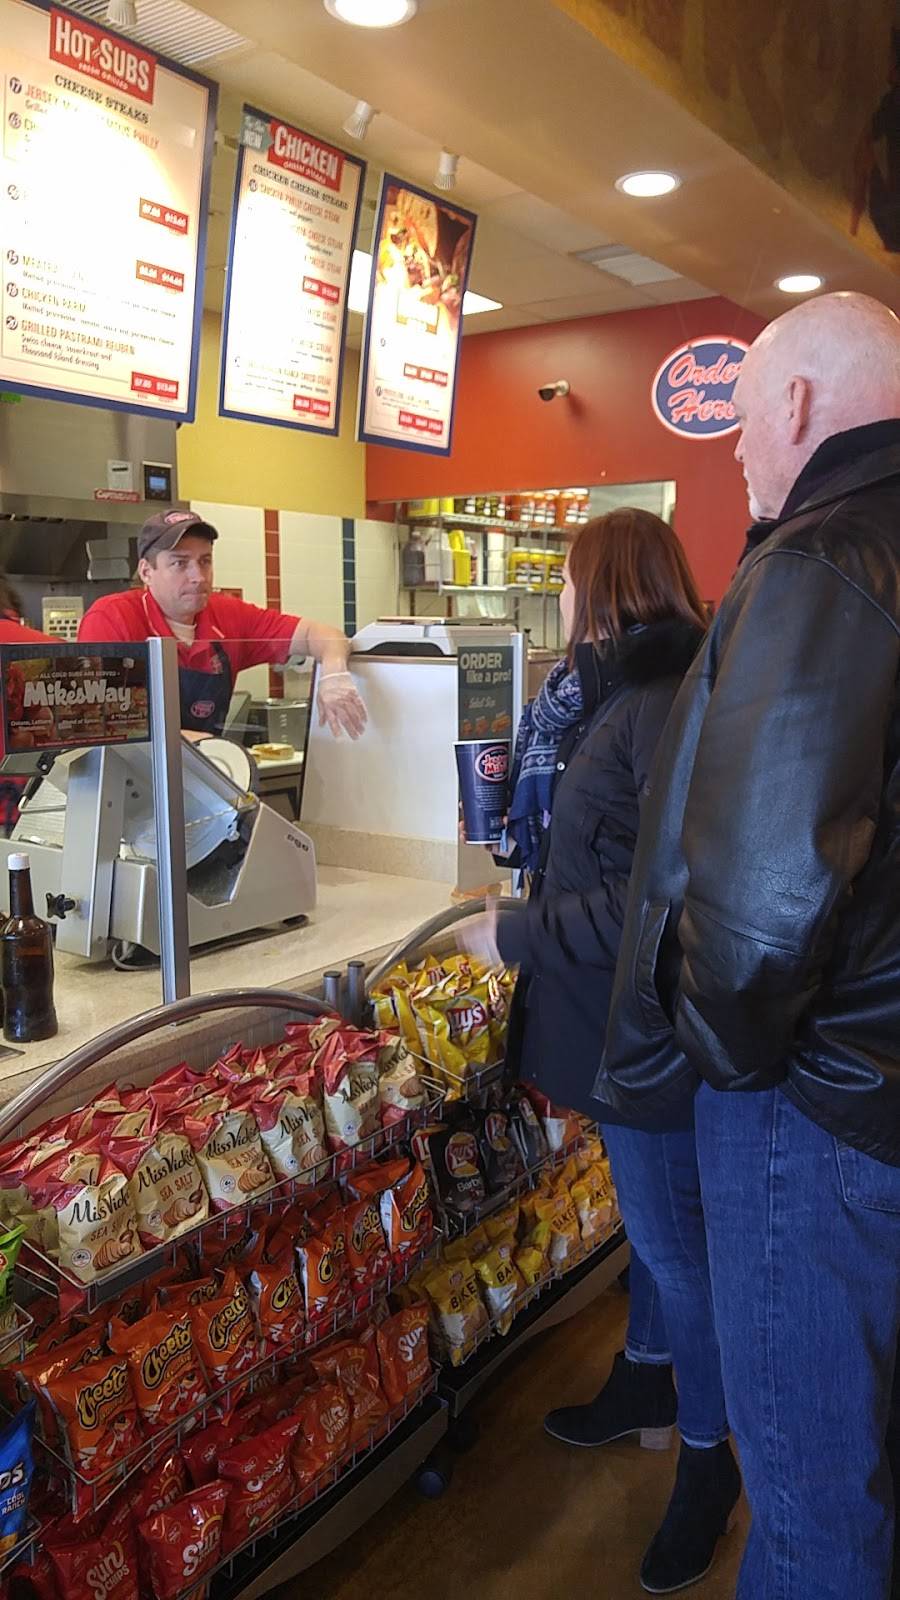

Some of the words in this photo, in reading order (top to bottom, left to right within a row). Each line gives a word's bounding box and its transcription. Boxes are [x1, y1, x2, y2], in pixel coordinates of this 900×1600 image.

[55, 16, 95, 63] HOT
[99, 38, 150, 93] SUBS
[54, 74, 103, 104] CHEESE
[105, 96, 150, 124] STEAKS
[274, 125, 338, 181] CHICKEN
[22, 287, 59, 307] CHICKEN
[21, 319, 57, 339] GRILLED
[59, 328, 102, 349] PASTRAMI
[105, 339, 136, 356] REUBEN
[21, 344, 52, 361] Thousand
[75, 355, 100, 373] dressing
[668, 352, 742, 388] Orde
[460, 652, 502, 670] ORDER
[465, 670, 483, 684] like
[485, 671, 492, 683] a
[23, 680, 86, 707] Mike's
[83, 679, 131, 712] Way
[280, 1112, 304, 1139] Miss
[206, 1138, 233, 1160] Miss
[242, 1146, 261, 1164] SALT
[138, 1164, 168, 1193] Miss
[160, 1184, 175, 1202] SEA
[174, 1171, 193, 1192] SALT
[91, 1228, 108, 1242] SEA
[86, 1539, 126, 1600] Sun
[105, 1563, 131, 1592] CHIPS
